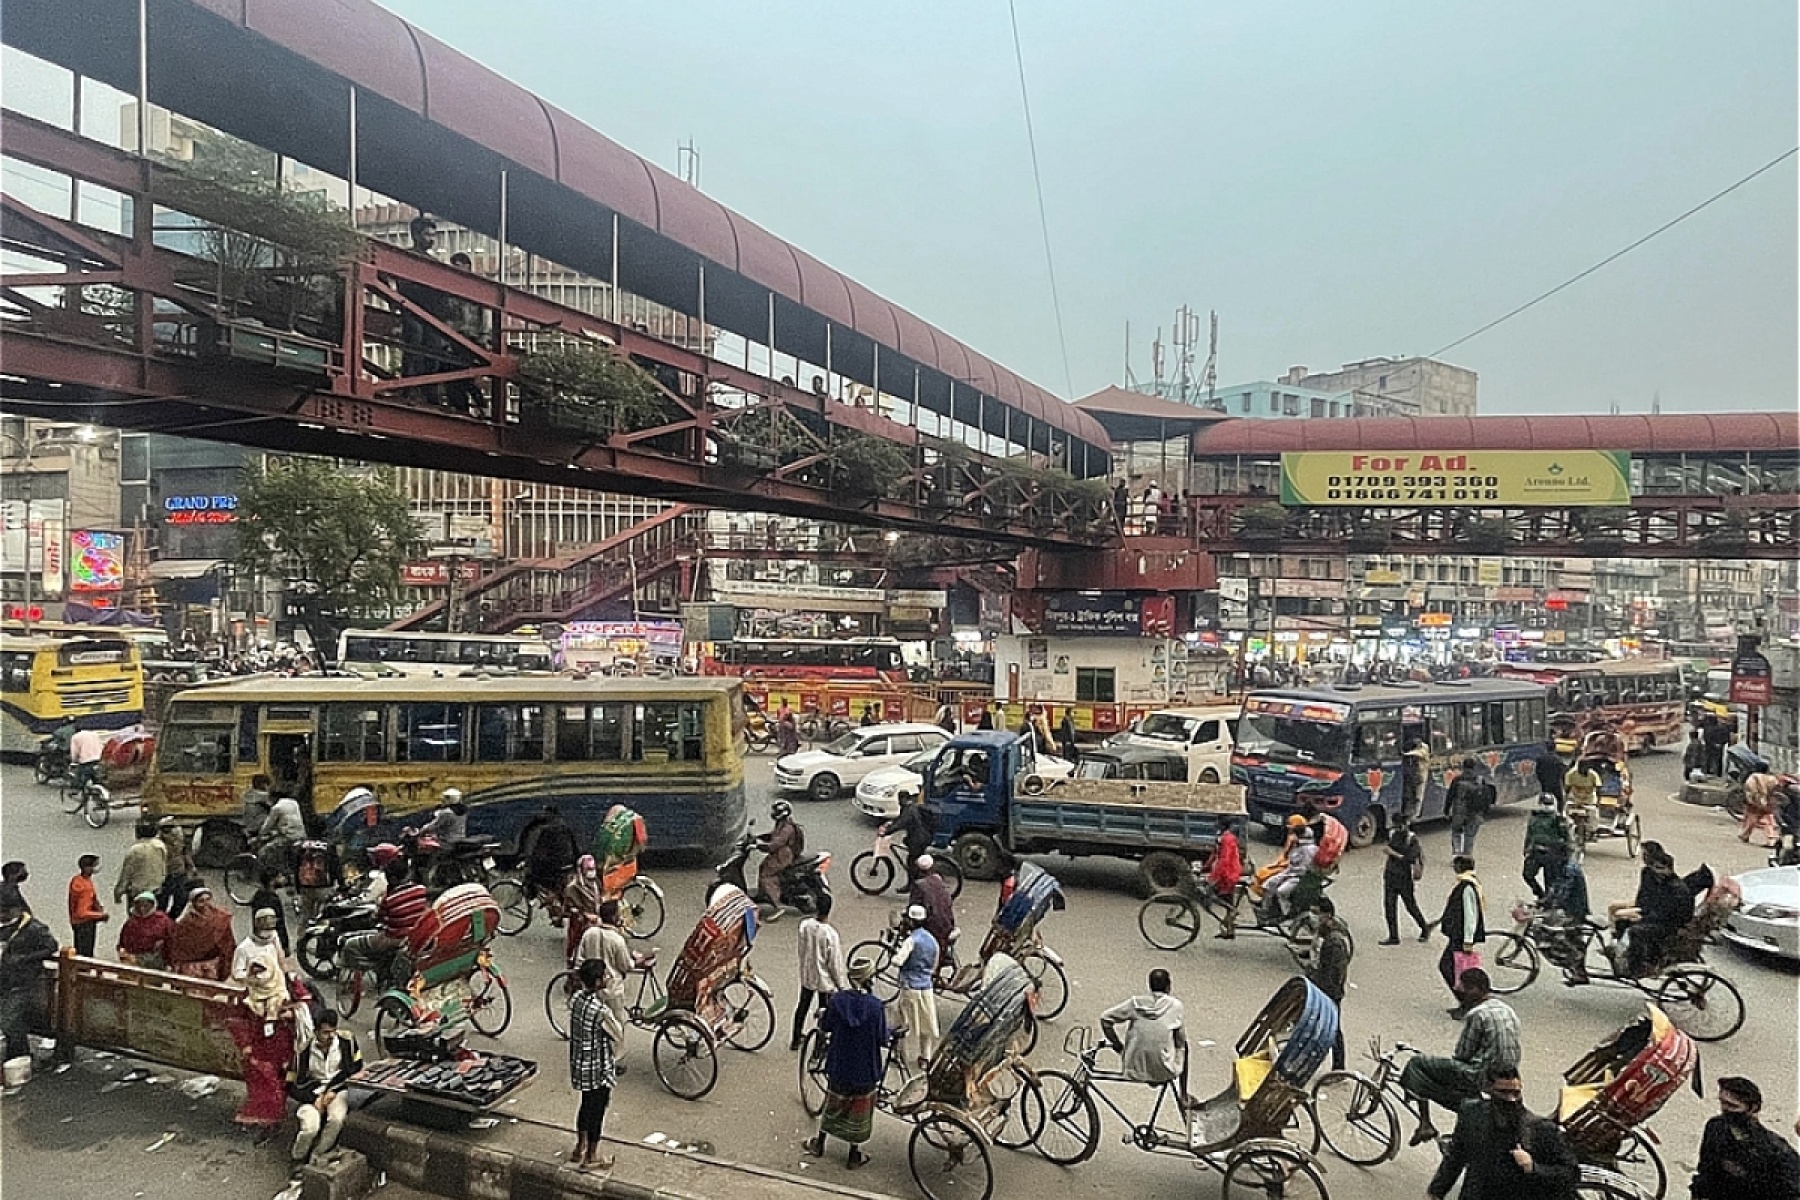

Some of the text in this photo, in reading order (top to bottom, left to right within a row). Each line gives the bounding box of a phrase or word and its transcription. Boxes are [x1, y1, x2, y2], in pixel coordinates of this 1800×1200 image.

[1352, 455, 1477, 471] For Ad.
[1328, 476, 1498, 487] 01709 393 360
[1568, 476, 1590, 486] Ltd.
[1328, 488, 1498, 499] 01866 741 018
[164, 495, 208, 510] GRAND
